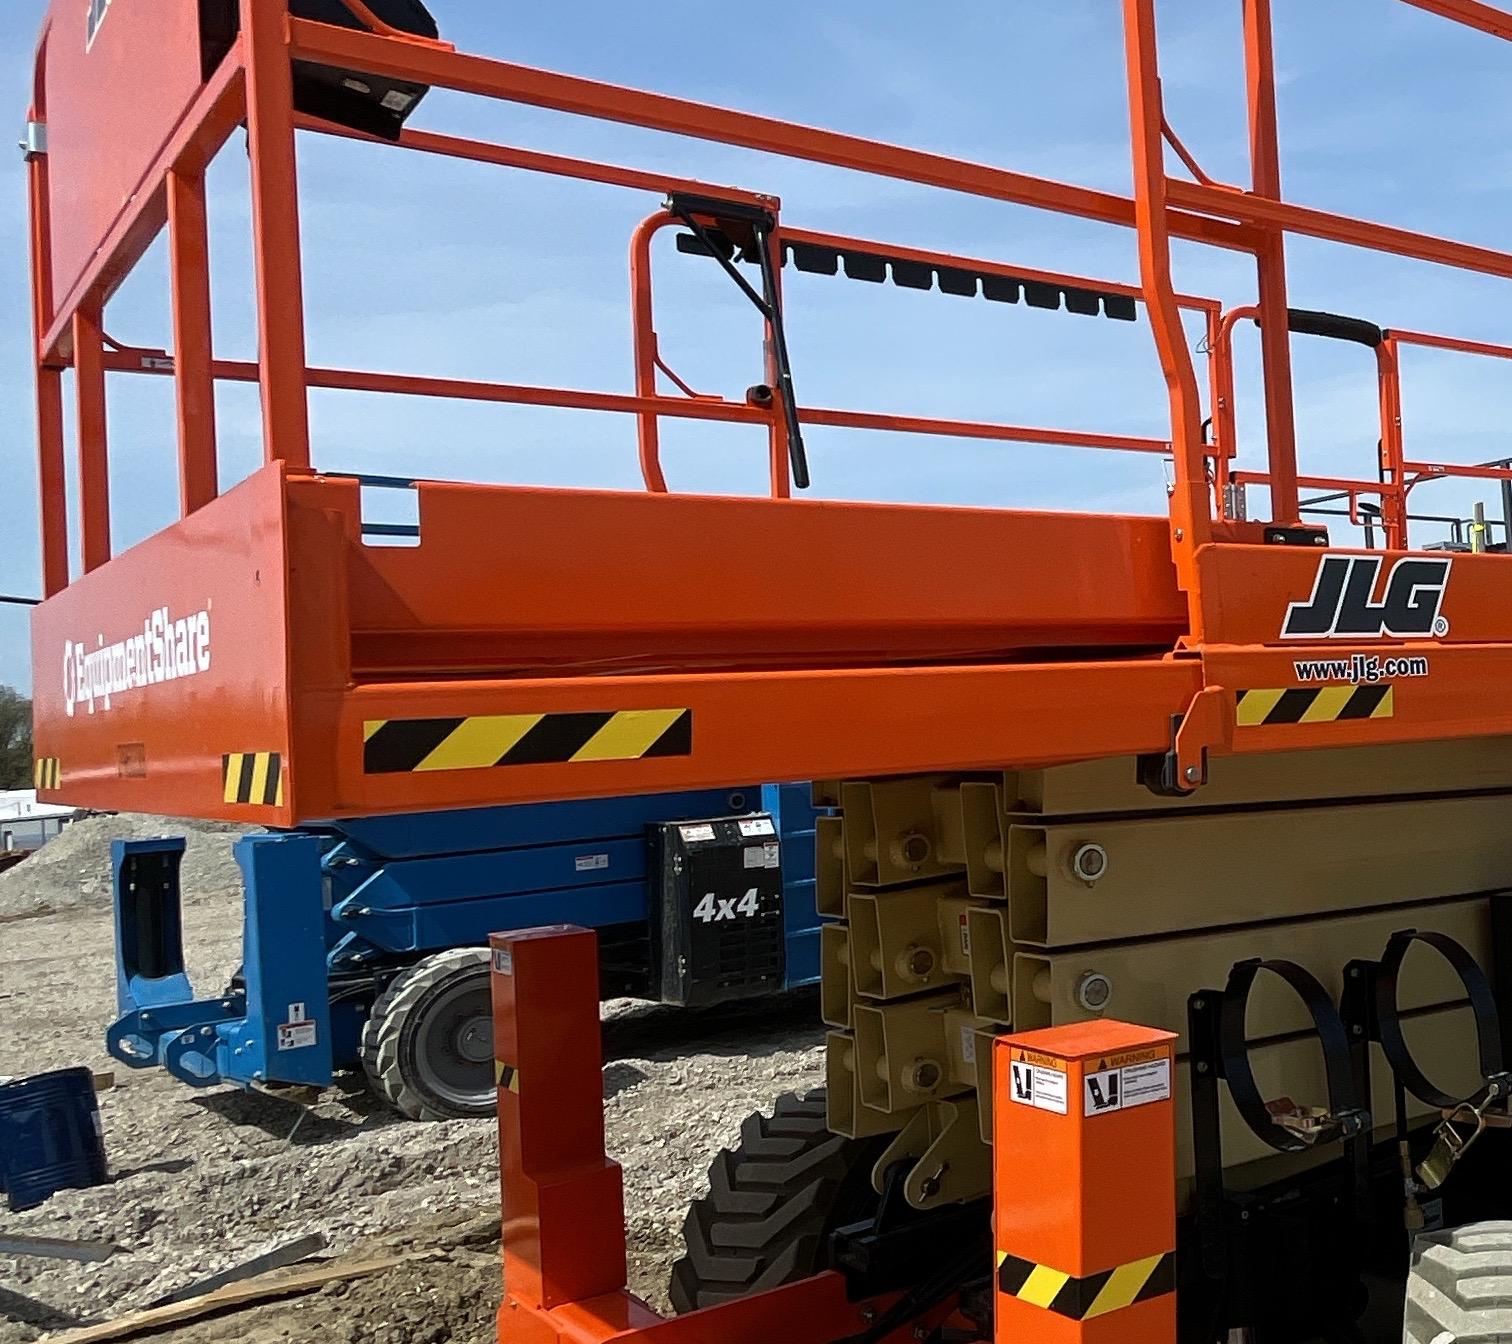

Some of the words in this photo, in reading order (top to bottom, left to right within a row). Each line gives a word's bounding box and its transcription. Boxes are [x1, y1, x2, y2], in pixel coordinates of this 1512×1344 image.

[1280, 554, 1452, 638] JLG
[74, 606, 211, 714] EquipmentShare
[1293, 655, 1429, 684] www.jlg.com
[692, 887, 760, 923] 4x4
